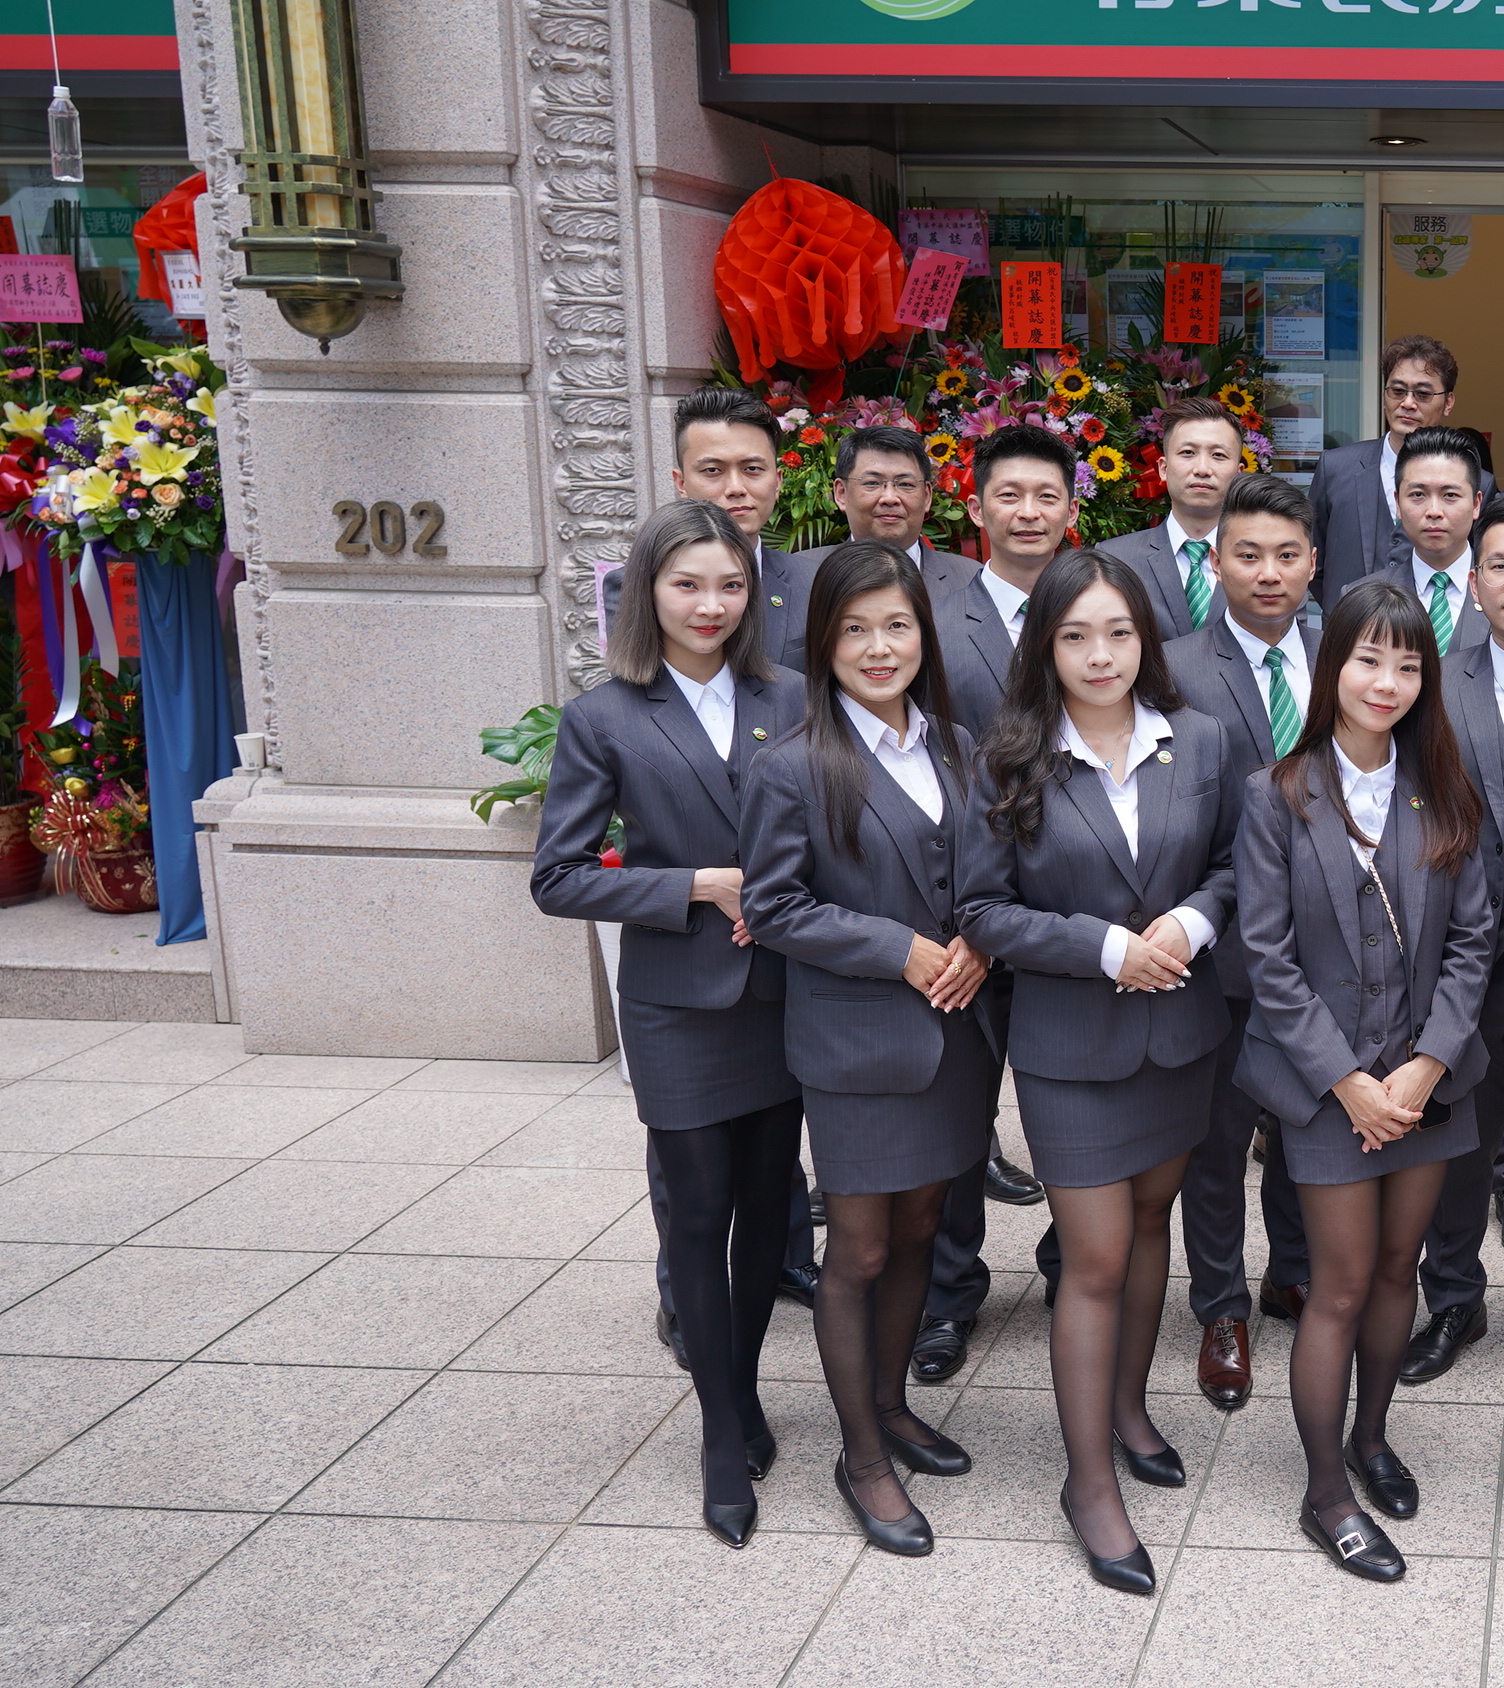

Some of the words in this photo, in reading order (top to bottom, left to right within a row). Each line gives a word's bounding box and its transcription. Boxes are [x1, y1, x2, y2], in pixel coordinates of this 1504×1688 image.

[907, 231, 983, 246] 開幕誌慶
[1414, 216, 1447, 232] 服務
[2, 271, 70, 298] 開幕誌慶
[918, 265, 946, 323] 開幕誌慶
[1028, 270, 1044, 344] 開幕誌慶
[1187, 270, 1204, 339] 開幕誌慶
[333, 499, 449, 556] 202
